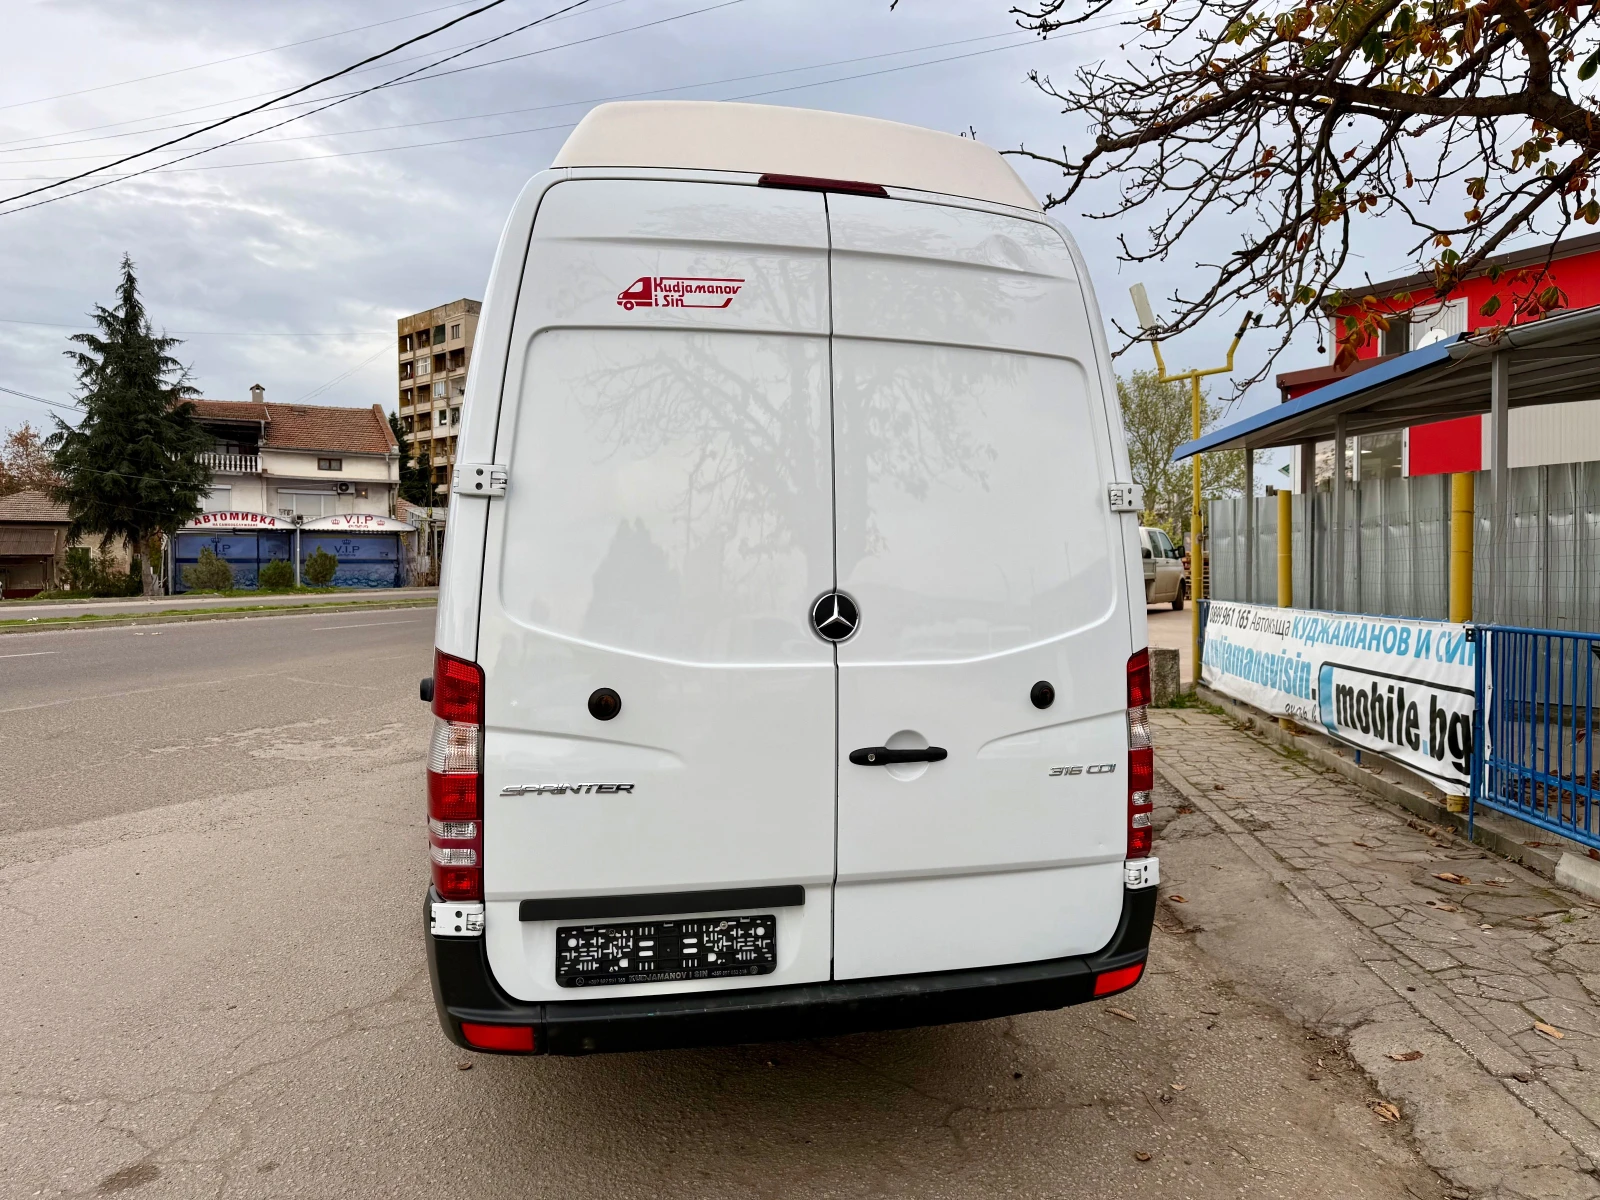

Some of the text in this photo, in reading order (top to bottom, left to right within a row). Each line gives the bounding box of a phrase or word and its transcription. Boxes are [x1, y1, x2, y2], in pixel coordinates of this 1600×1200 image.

[653, 277, 742, 298] Kudjamanov
[662, 295, 684, 308] Sin
[194, 512, 276, 527] АВТОМИВКА
[344, 515, 374, 524] V.I.P
[1222, 607, 1236, 627] 961
[1235, 609, 1251, 630] 165
[1249, 611, 1291, 640] Автокъща
[1291, 616, 1412, 656] КУДЖАМАНОВ
[1414, 629, 1432, 660] И
[1335, 681, 1473, 776] mobile.bg
[1048, 763, 1116, 776] 316 CDI
[499, 782, 635, 797] SPRINTER
